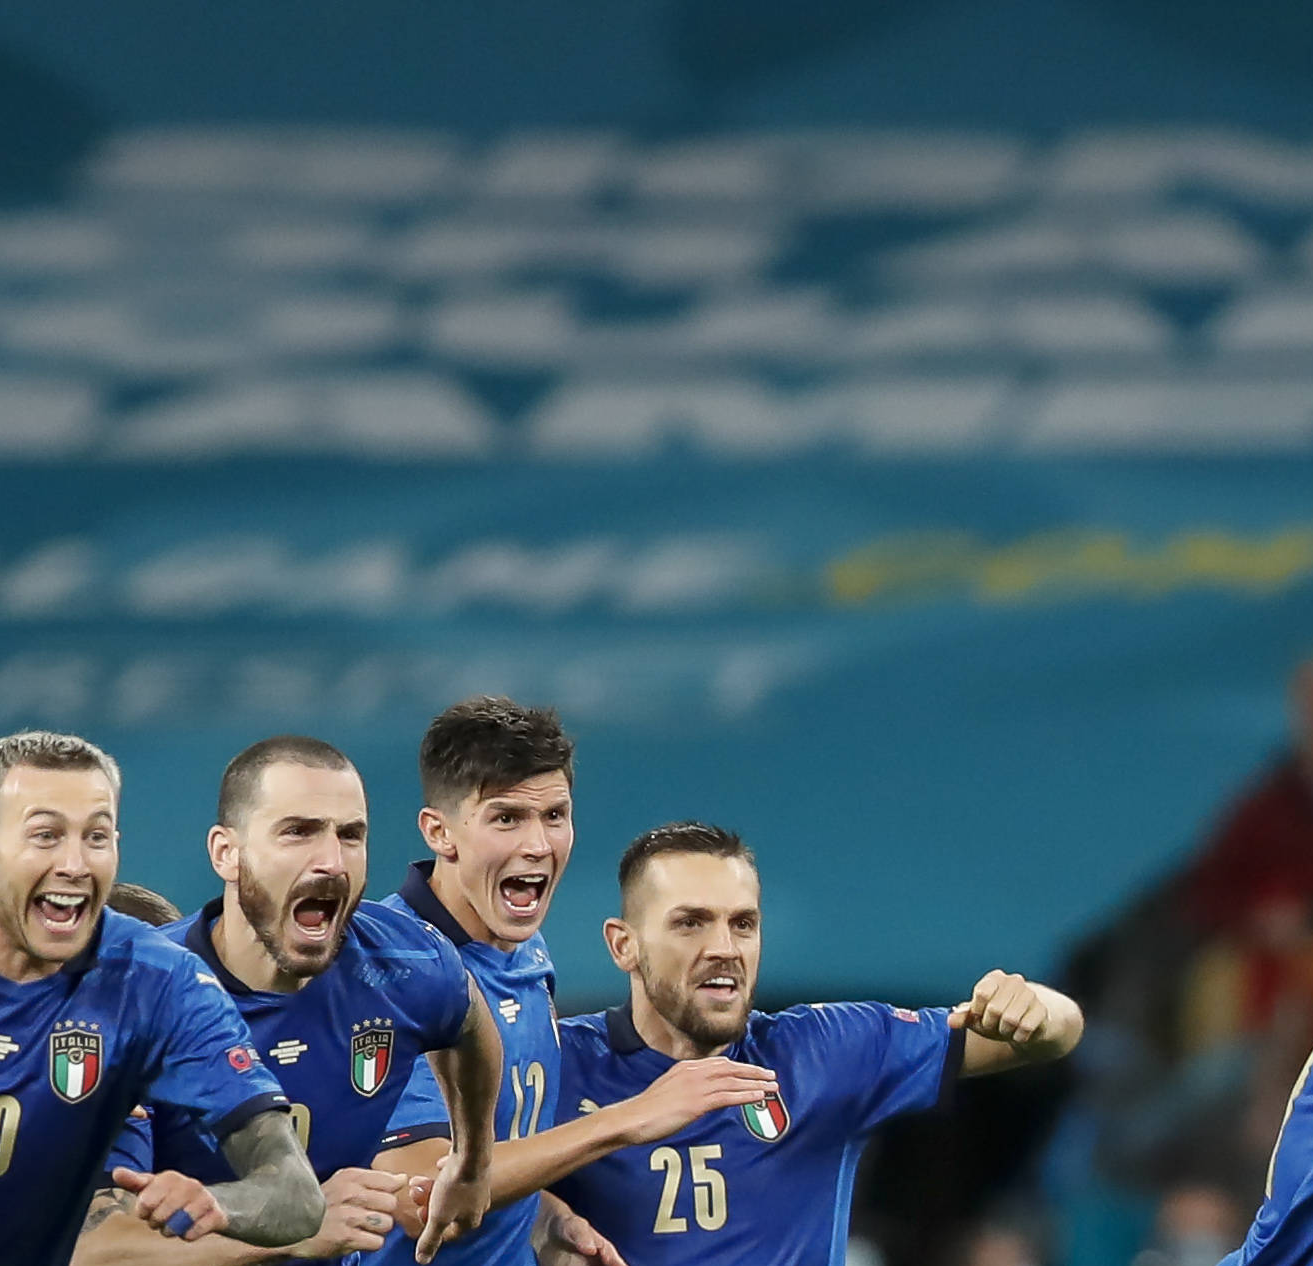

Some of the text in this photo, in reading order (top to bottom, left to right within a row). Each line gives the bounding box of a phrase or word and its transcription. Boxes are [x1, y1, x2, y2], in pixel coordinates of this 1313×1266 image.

[54, 1035, 98, 1049] ITALIA
[354, 1033, 390, 1050] ITALIA
[649, 1143, 728, 1234] 25
